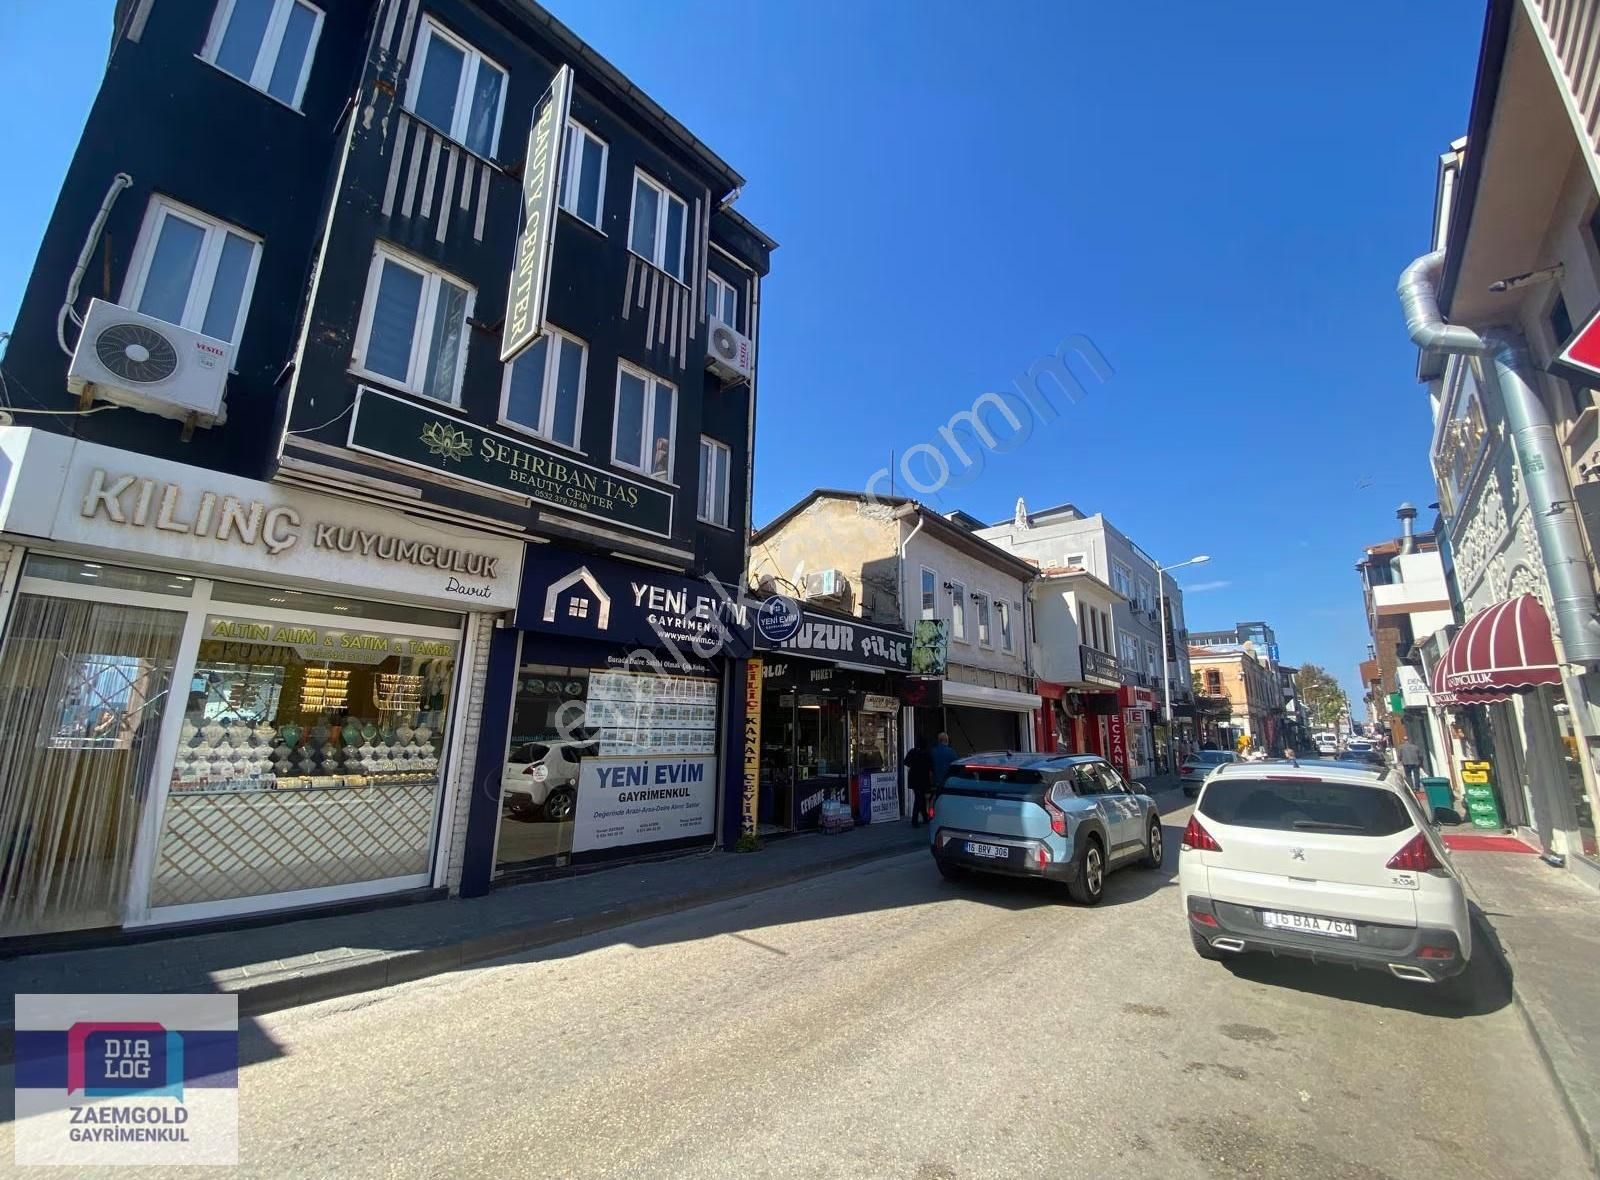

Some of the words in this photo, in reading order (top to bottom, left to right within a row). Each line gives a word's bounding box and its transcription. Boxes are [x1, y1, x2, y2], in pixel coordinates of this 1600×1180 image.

[511, 211, 540, 341] CENTER
[196, 342, 223, 356] VESTEL
[480, 437, 597, 491] ŞEHRİBAN
[603, 480, 639, 508] TAŞ
[510, 470, 562, 495] BEAUTY
[565, 487, 613, 510] CENTER
[535, 489, 554, 501] 0532
[82, 469, 301, 555] KILINÇ
[316, 523, 499, 579] KUYUMCULUK
[445, 576, 491, 599] Davut
[631, 582, 687, 614] YENİ
[696, 596, 747, 626] EVİM
[761, 615, 778, 626] YENİ
[780, 613, 797, 623] EVİM
[213, 621, 270, 641] ALTIN
[274, 627, 317, 644] ALIM
[323, 636, 332, 646] &
[340, 635, 388, 651] SATIM
[408, 640, 453, 656] TAMİR
[861, 636, 908, 666] PİLİÇ
[745, 717, 758, 764] KANAT
[1111, 714, 1123, 769] ECZAN
[596, 760, 649, 788] YENİ
[655, 759, 704, 785] EVİM
[619, 787, 690, 802] GAYRİMENKUL
[968, 842, 975, 850] 16
[978, 843, 992, 854] BRV
[995, 847, 1008, 857] 306
[1275, 912, 1289, 925] 16
[1293, 914, 1320, 930] BAA
[1326, 919, 1352, 934] 764
